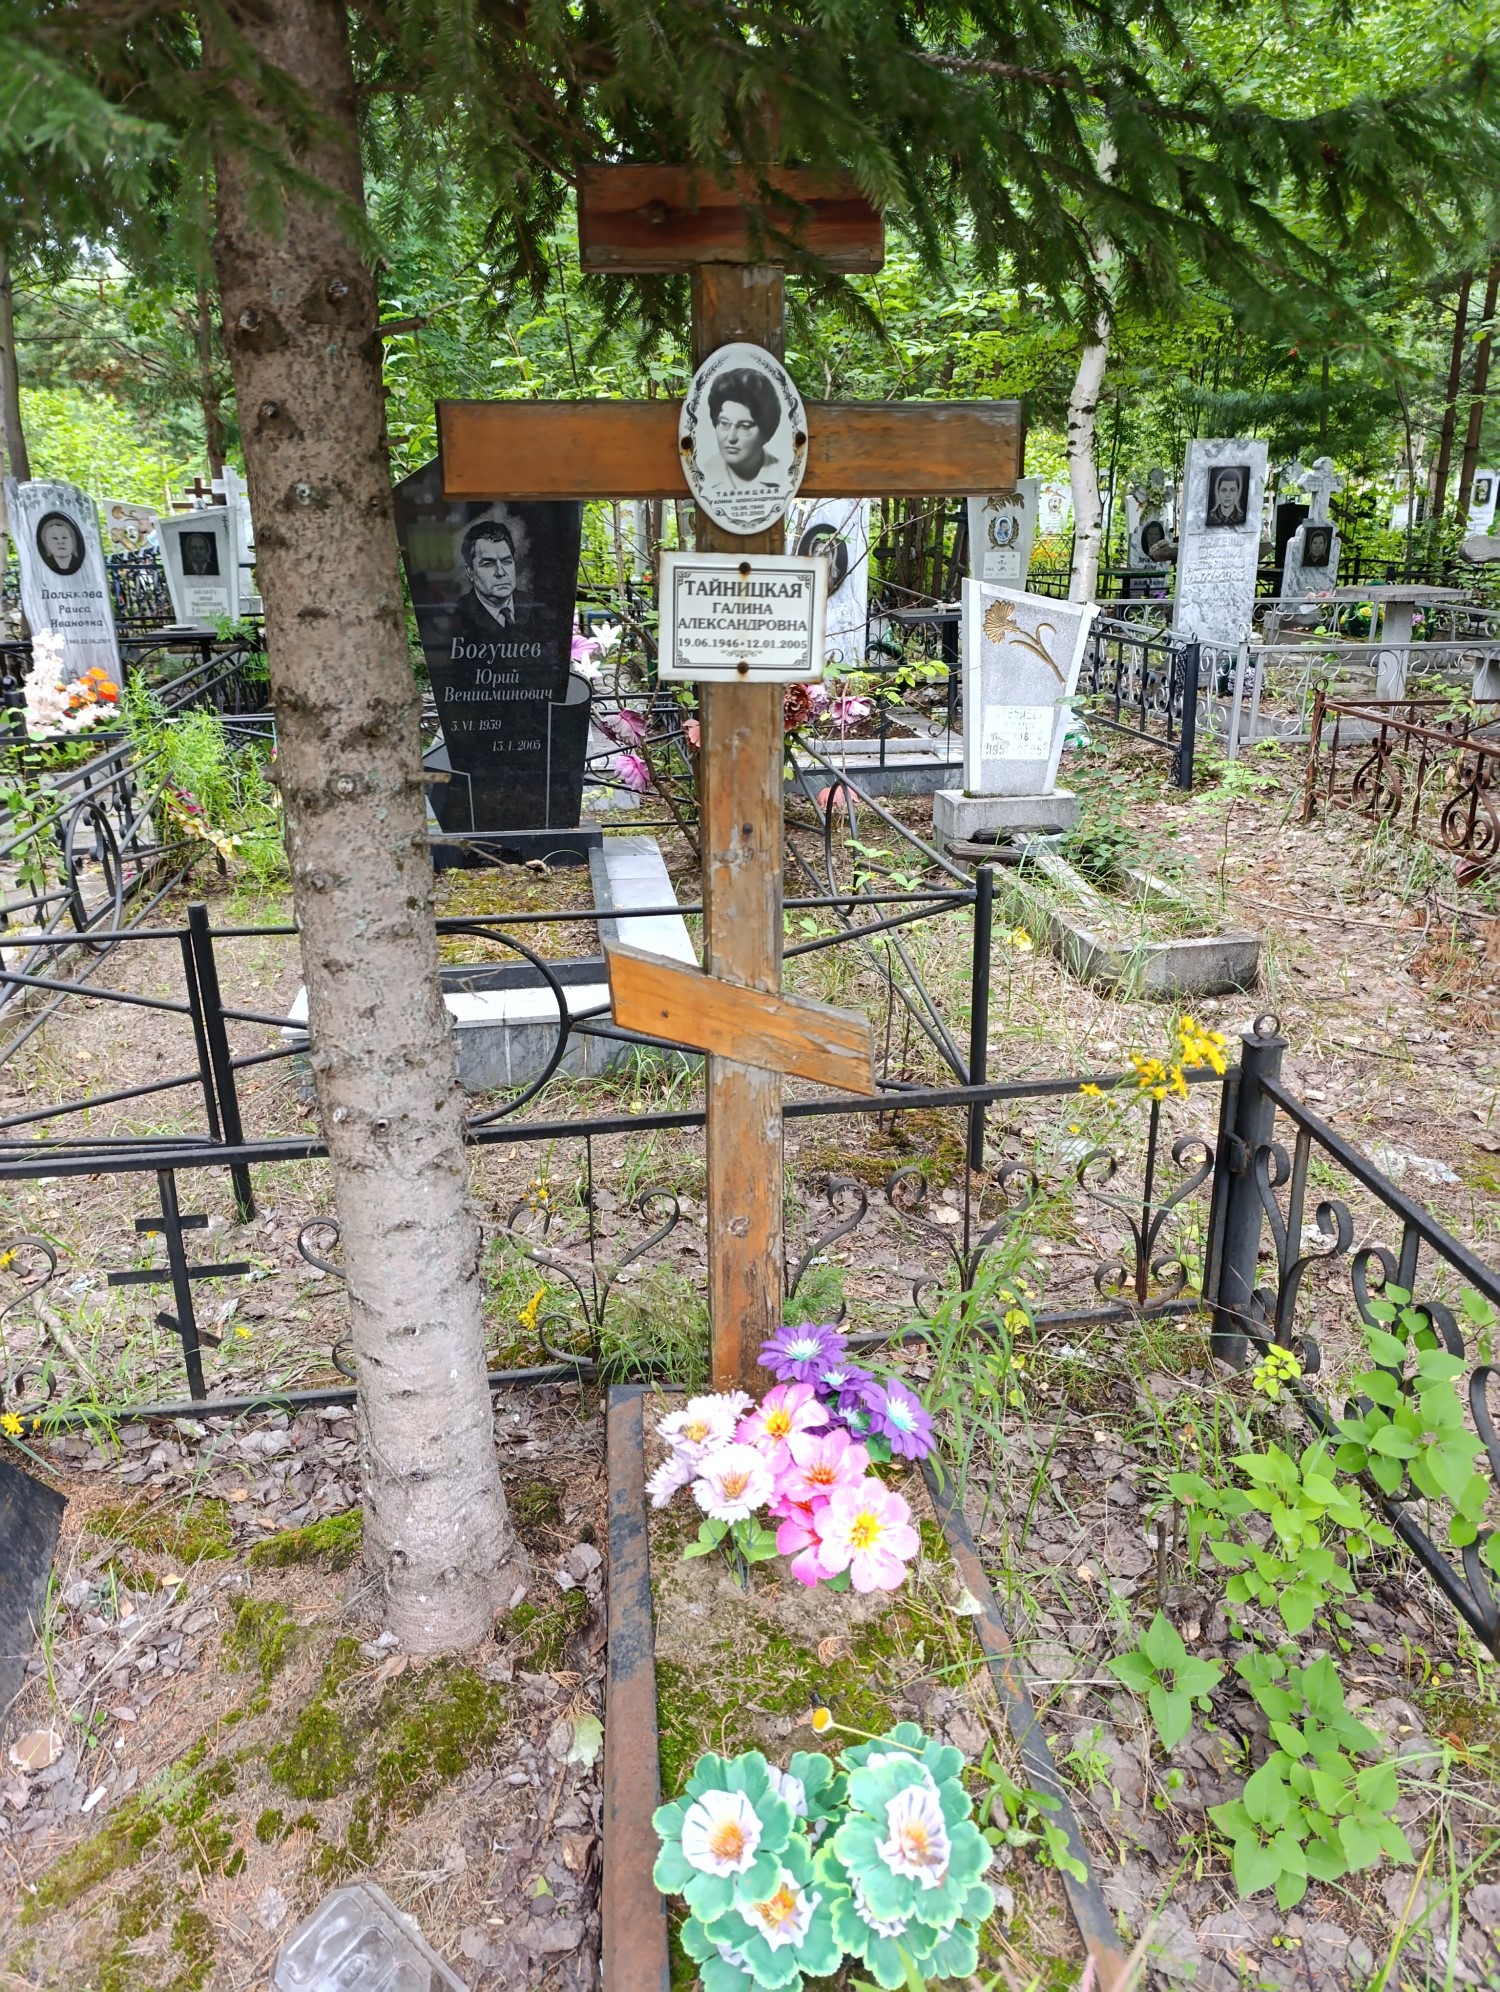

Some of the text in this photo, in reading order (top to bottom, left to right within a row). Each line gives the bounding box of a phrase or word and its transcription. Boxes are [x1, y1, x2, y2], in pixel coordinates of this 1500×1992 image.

[716, 488, 780, 498] ТАЙНИЦКАЯ
[735, 495, 785, 503] АЛЕКСАНДРОВНА
[41, 589, 103, 600] Полякова
[684, 578, 803, 599] ТАЙНИЦКАЯ
[58, 605, 92, 614] Раиса
[712, 602, 774, 615] ГАЛИНА
[50, 618, 104, 628] Ивановна
[677, 617, 808, 632] АЛЕКСАНДРОВНА
[449, 637, 542, 665] Богушев
[475, 668, 521, 689] Юрий
[444, 686, 553, 702] Вениаминович
[517, 740, 542, 751] 2005
